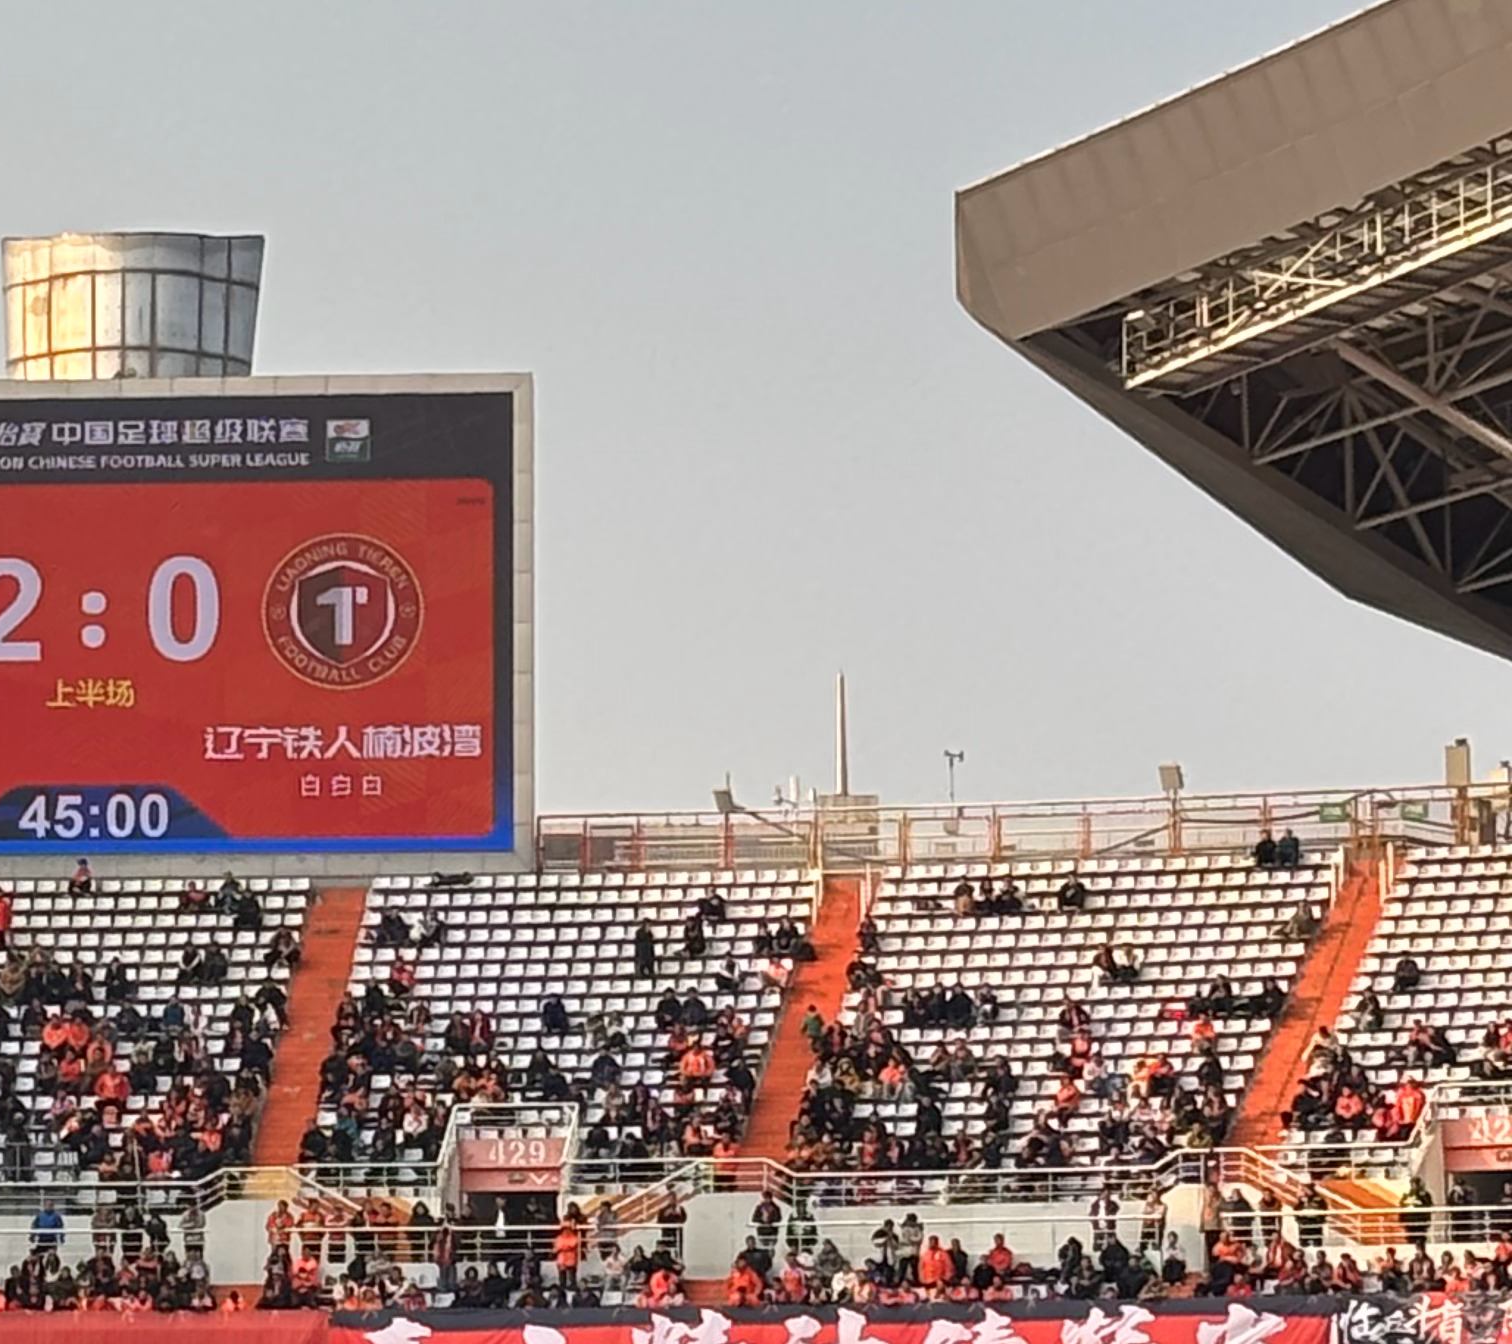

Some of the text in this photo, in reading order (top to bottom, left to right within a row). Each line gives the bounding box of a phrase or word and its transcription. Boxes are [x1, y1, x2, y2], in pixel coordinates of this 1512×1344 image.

[28, 455, 97, 470] CHINESE
[100, 454, 185, 469] FOOTBALL
[189, 453, 243, 467] SUPER
[246, 452, 310, 466] LEAGUE
[277, 635, 409, 683] FOOTBALL CLUB
[46, 678, 135, 708] 上半场
[203, 723, 483, 760] 辽宁铁人楠波湾
[18, 793, 170, 838] 45:00
[488, 1140, 546, 1166] 429
